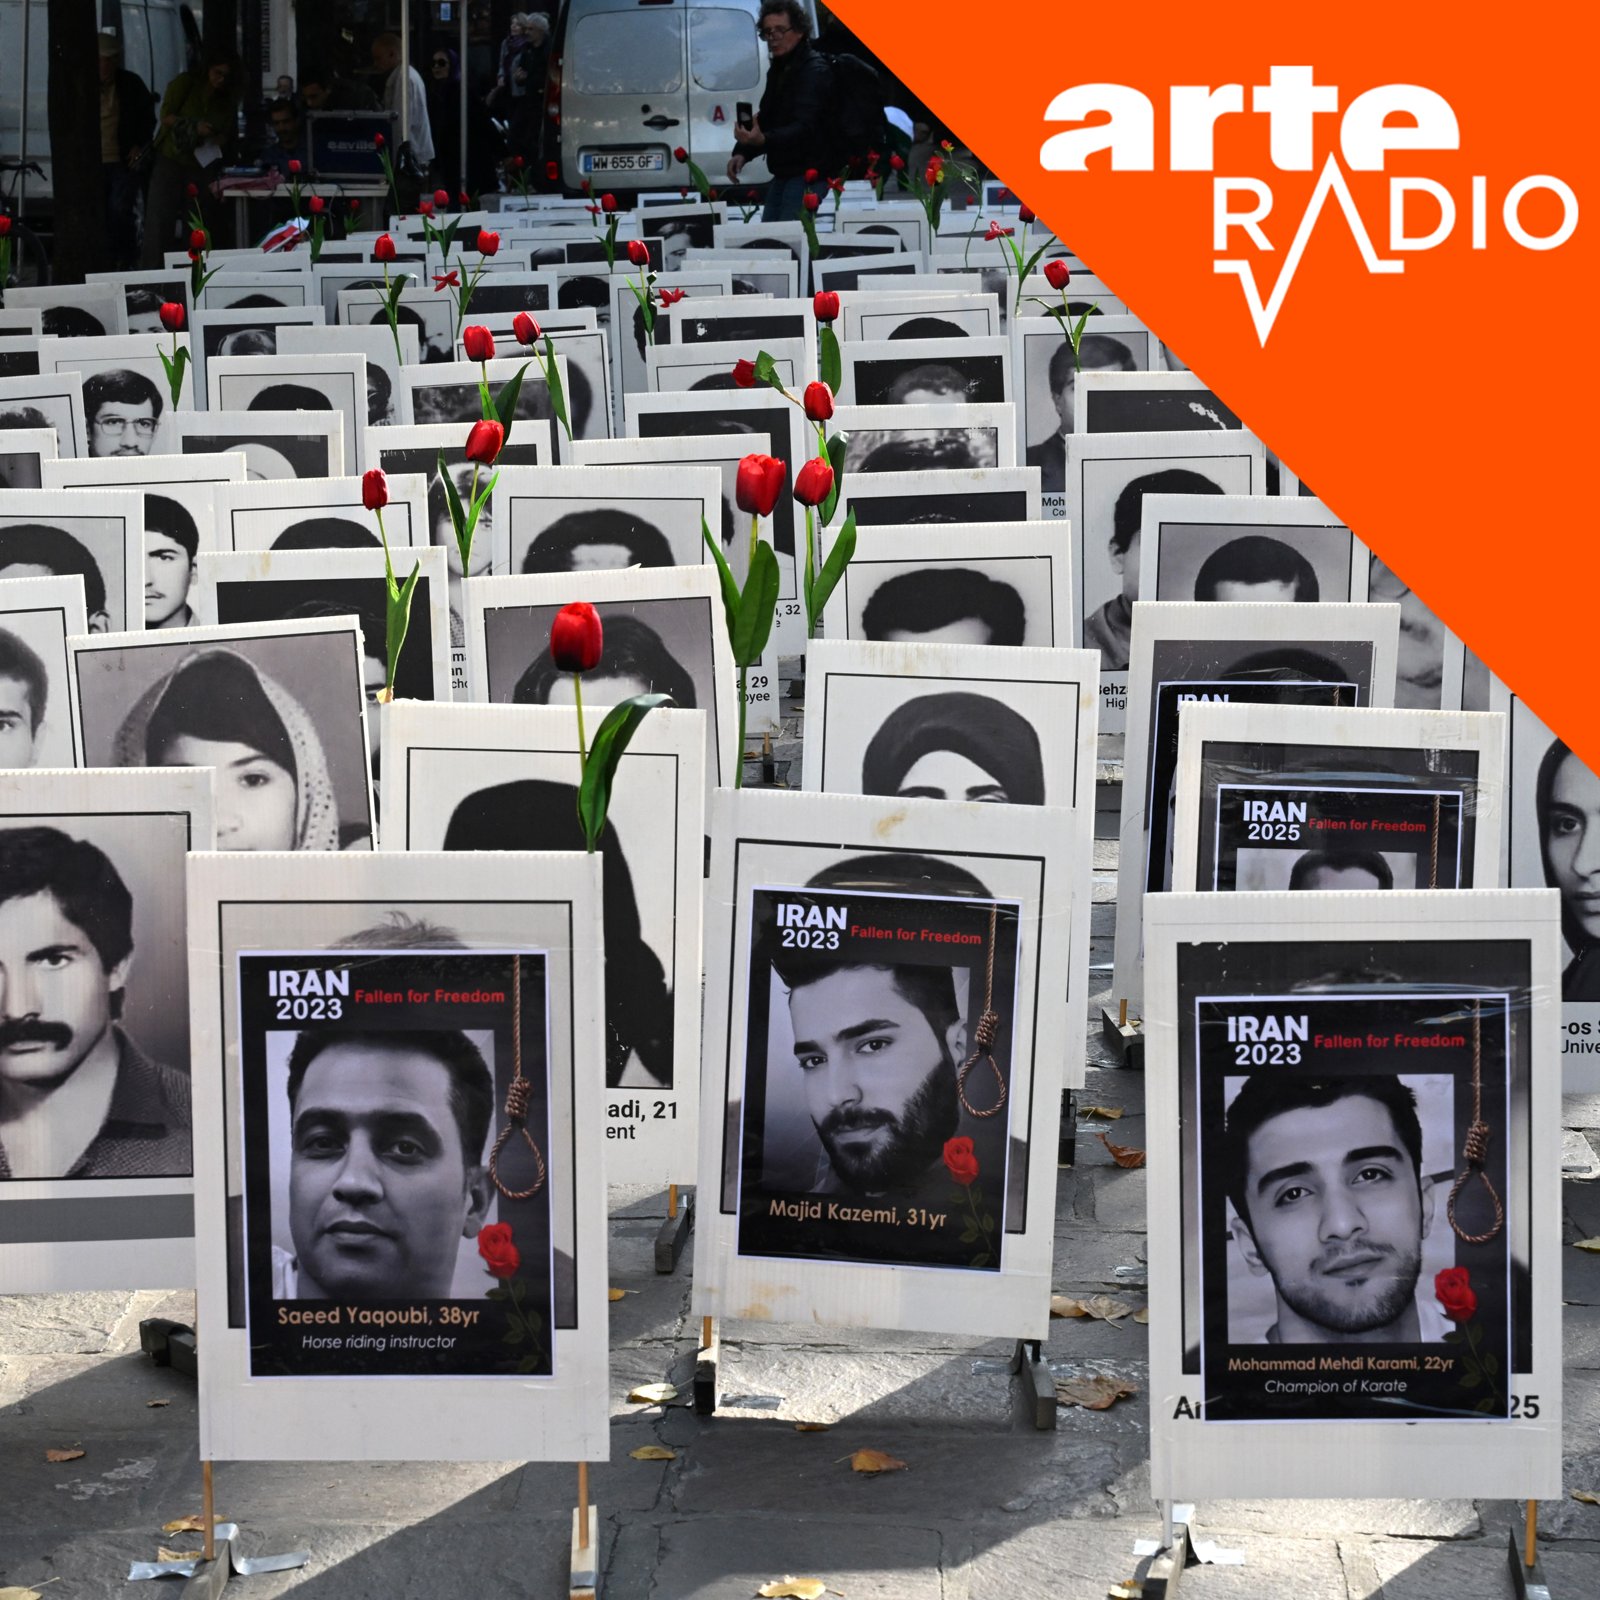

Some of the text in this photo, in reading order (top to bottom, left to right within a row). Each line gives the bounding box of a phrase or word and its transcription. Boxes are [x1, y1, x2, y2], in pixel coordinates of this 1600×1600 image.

[713, 105, 725, 121] A
[1053, 508, 1066, 517] Co
[785, 604, 800, 615] 32
[751, 676, 768, 689] 29
[1099, 683, 1128, 695] ehz
[1106, 697, 1127, 710] Hig
[1243, 800, 1307, 823] IRAN
[1248, 823, 1300, 841] 2025
[1308, 818, 1427, 832] Fallen for Freedom
[776, 903, 848, 930] IRAN
[782, 929, 840, 950] 2023
[850, 925, 982, 945] Fallen for Freedom
[269, 970, 349, 996] IRAN
[354, 989, 505, 1003] Fallen for Freedom
[276, 998, 343, 1020] 2023
[1227, 1015, 1309, 1042] IRAN
[1314, 1033, 1466, 1048] Fallen for Freedom
[1235, 1043, 1301, 1065] 2023
[605, 1099, 677, 1122] adi, 21
[606, 1124, 636, 1140] ent
[769, 1200, 947, 1230] Majid Kazemi, 31yr
[278, 1306, 480, 1328] Saeed Yaqoubi, 38yr
[302, 1334, 457, 1351] Horse riding instructor
[1228, 1356, 1454, 1372] Mohammad Mehdi Karami, 22yr
[1264, 1379, 1408, 1395] Champion of Karate
